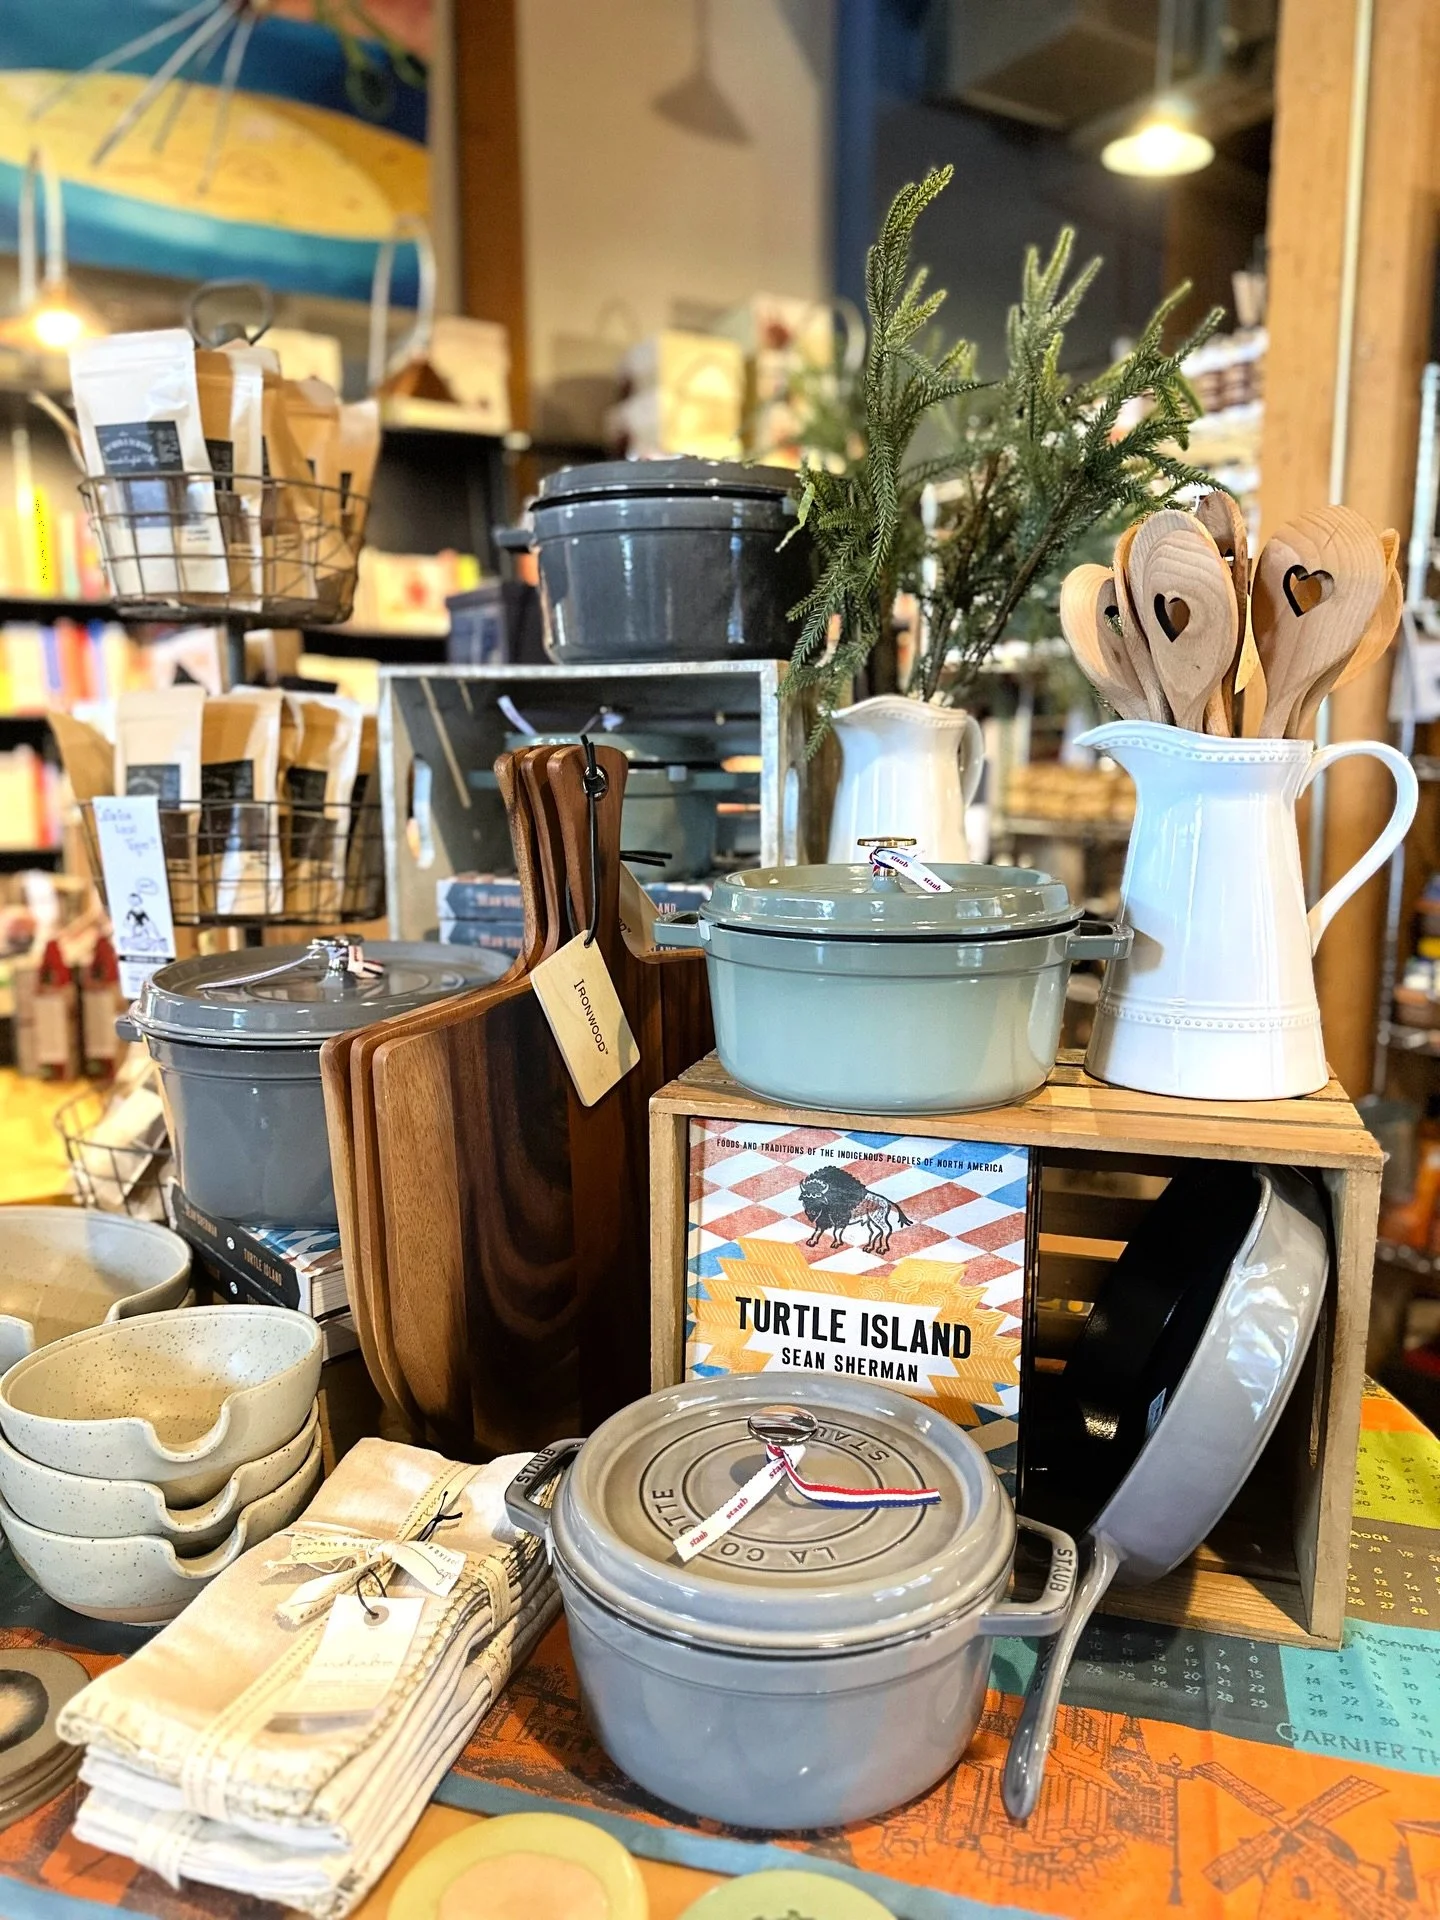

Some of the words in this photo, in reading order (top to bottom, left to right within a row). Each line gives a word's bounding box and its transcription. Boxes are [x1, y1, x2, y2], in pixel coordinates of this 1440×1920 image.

[890, 855, 909, 868] staub
[923, 877, 942, 892] staub
[717, 1139, 740, 1149] FOODS
[743, 1142, 757, 1151] AND
[761, 1143, 804, 1155] TRADITIONS
[807, 1147, 816, 1156] OF
[820, 1148, 834, 1158] THE
[837, 1149, 884, 1162] INDIGENOUS
[886, 1154, 921, 1166] PEOPLES
[924, 1158, 933, 1167] OF
[937, 1159, 964, 1170] NORTH
[967, 1163, 1003, 1173] AMERICA
[243, 1247, 262, 1273] TURTLE
[262, 1262, 283, 1287] ISLAND
[735, 1296, 847, 1344] TURTLE
[860, 1312, 972, 1360] ISLAND
[781, 1347, 825, 1370] SEAN
[834, 1354, 919, 1383] SHERMAN
[818, 1427, 890, 1461] STAU
[516, 1447, 556, 1485] STAUB
[769, 1460, 789, 1479] stau
[726, 1497, 749, 1520] staub
[689, 1530, 709, 1548] staub
[1050, 1547, 1073, 1592] STAUB
[1373, 1567, 1383, 1575] 6
[1375, 1589, 1393, 1598] 20
[1380, 1601, 1396, 1610] 27
[1185, 1645, 1195, 1653] 6
[1119, 1670, 1136, 1682] 25
[1185, 1685, 1202, 1696] 27
[1152, 1665, 1168, 1676] 19
[1183, 1671, 1202, 1681] 20
[1248, 1683, 1266, 1694] 22
[1247, 1669, 1264, 1679] 15
[1341, 1695, 1360, 1706] 22
[1379, 1715, 1400, 1728] 30
[1275, 1722, 1408, 1762] GARNIER
